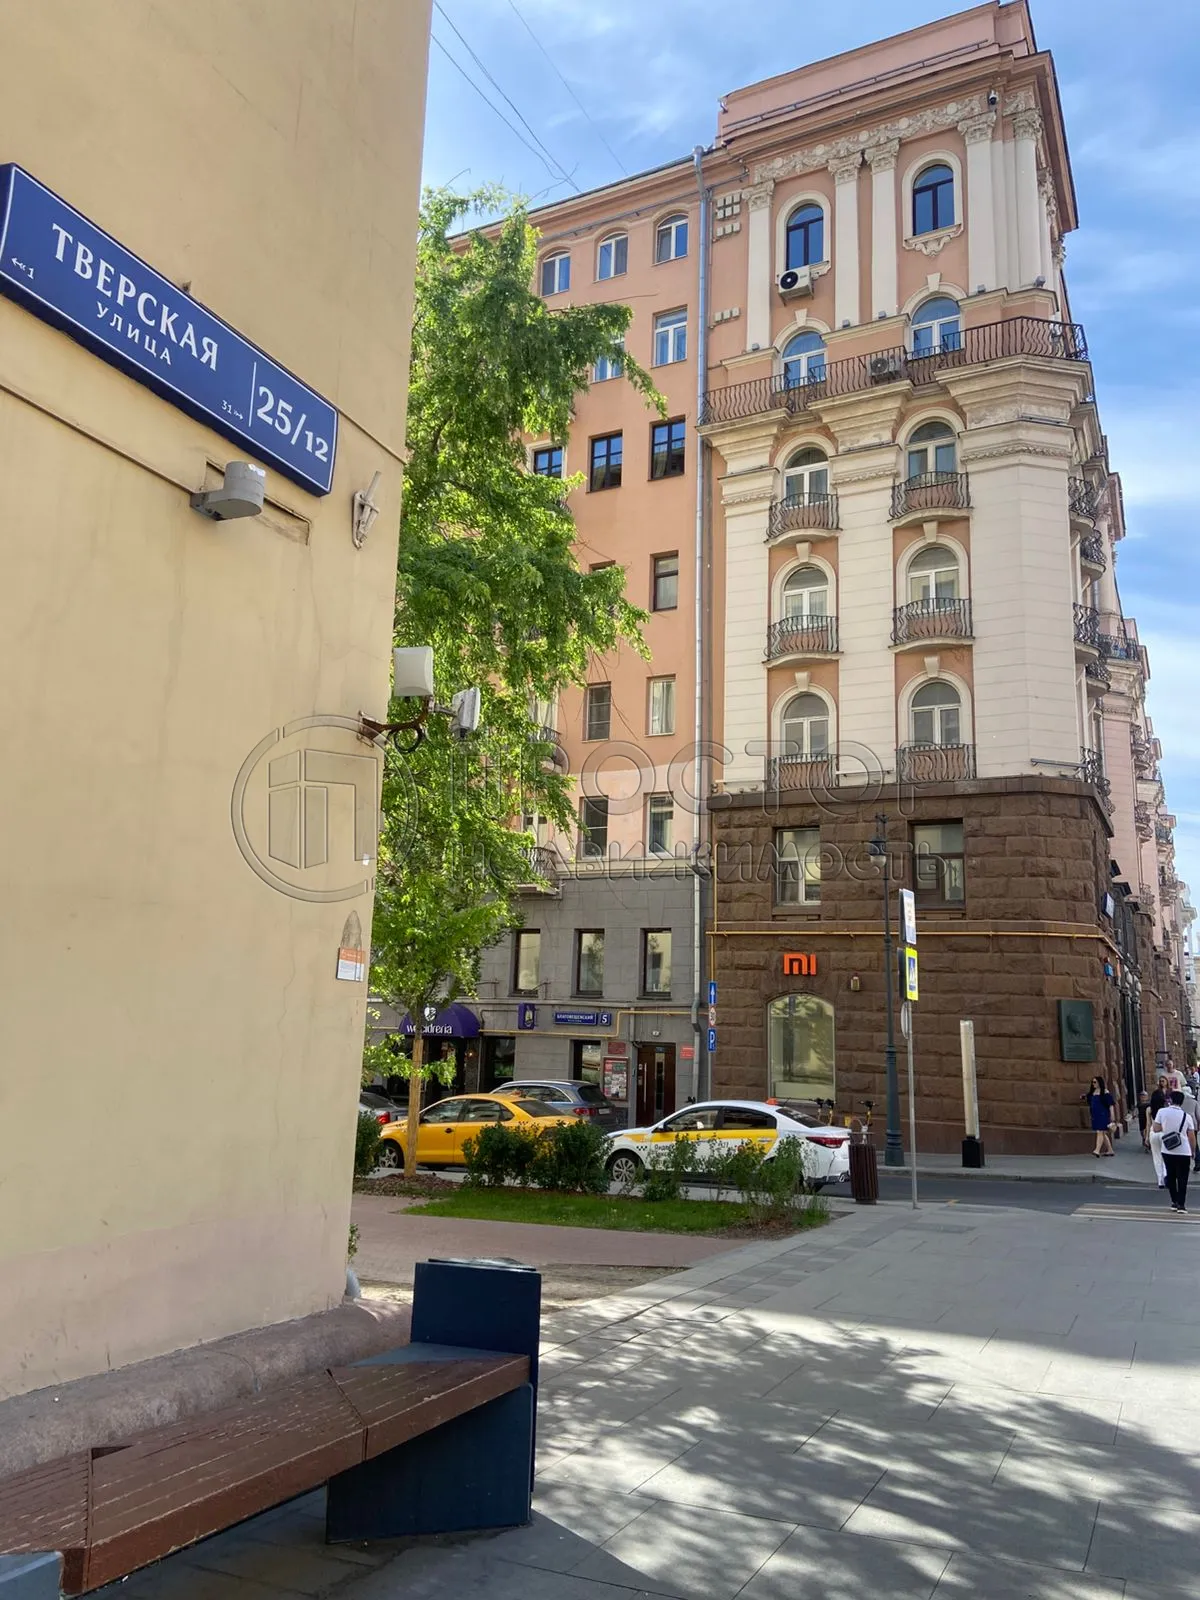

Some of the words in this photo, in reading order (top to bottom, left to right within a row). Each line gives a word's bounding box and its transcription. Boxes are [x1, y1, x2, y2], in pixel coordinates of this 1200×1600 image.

[27, 266, 35, 280] 1
[52, 223, 219, 371] ТВЕРСКАЯ
[96, 301, 172, 366] УЛИЦА
[221, 400, 232, 415] 31
[256, 386, 329, 463] 25/12
[601, 1014, 608, 1024] 5
